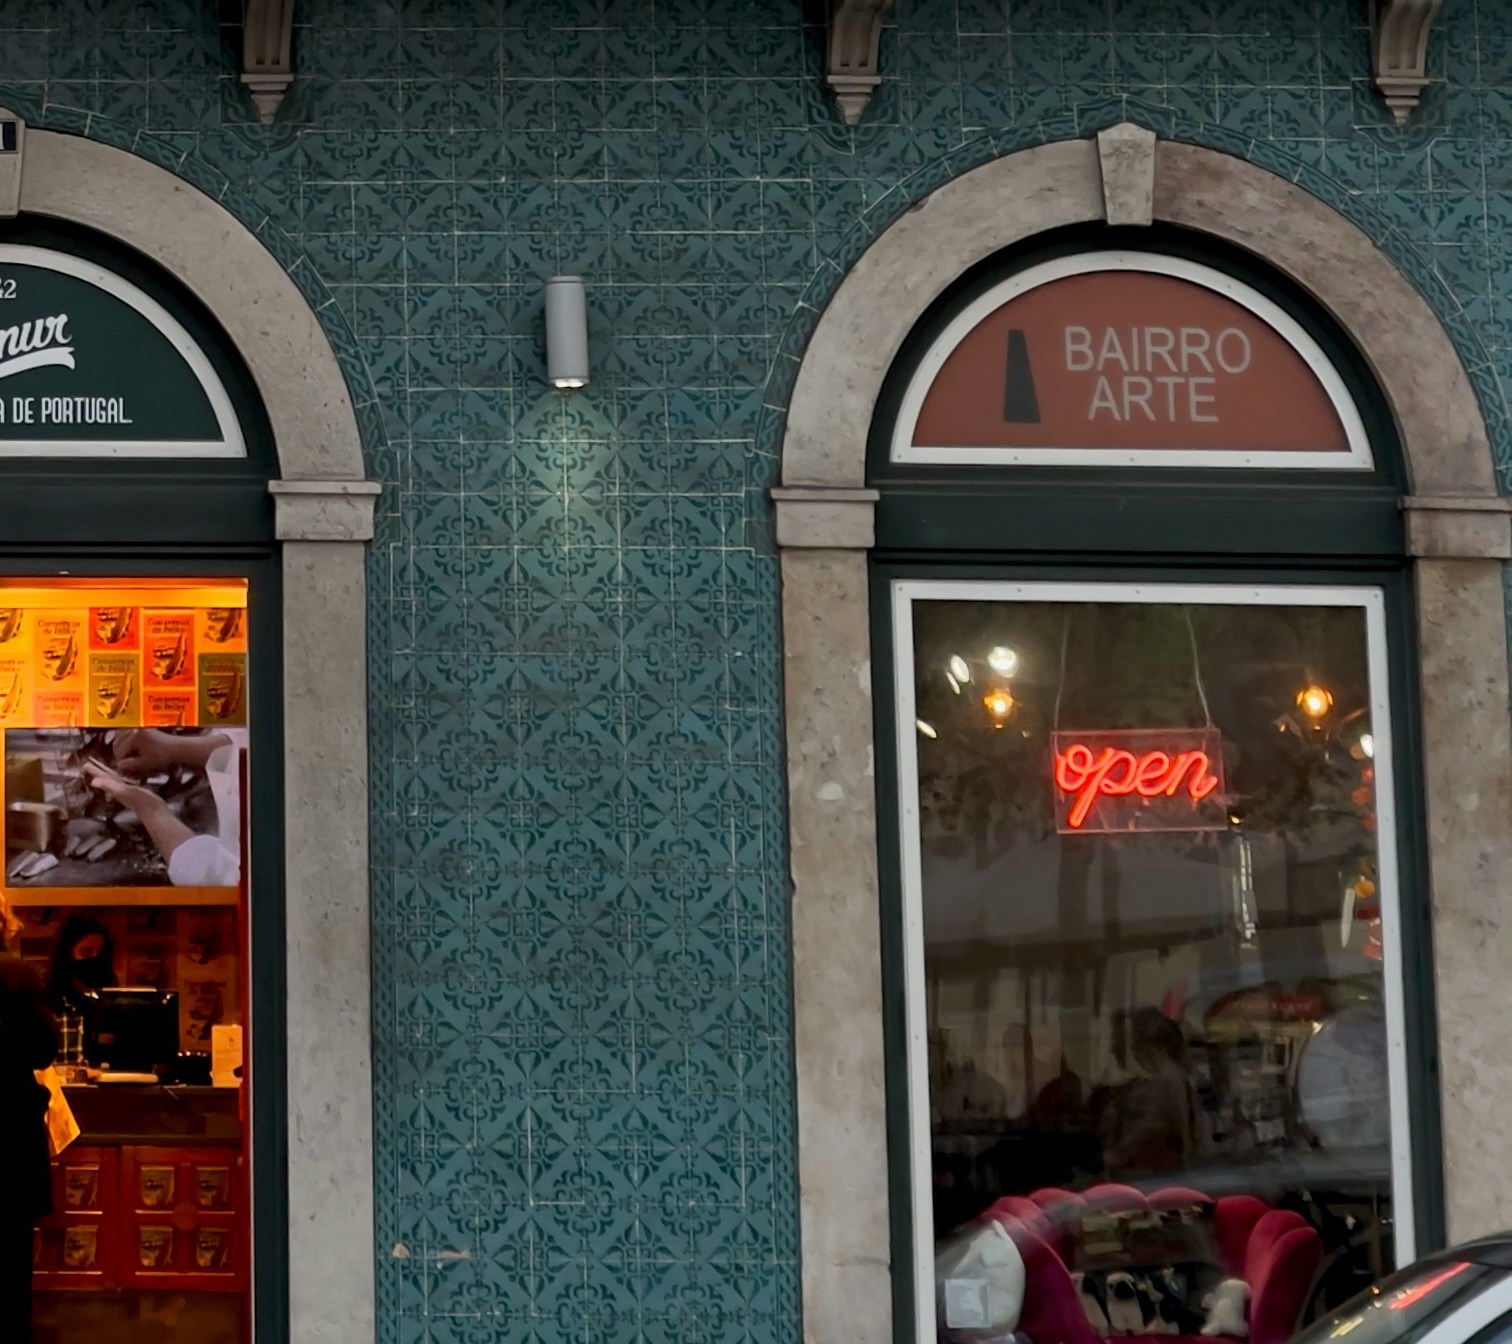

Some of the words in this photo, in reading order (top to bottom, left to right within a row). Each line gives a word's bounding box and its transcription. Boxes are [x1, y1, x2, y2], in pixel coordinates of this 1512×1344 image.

[1064, 326, 1252, 374] BAIRRO
[12, 397, 35, 424] DE
[1088, 375, 1219, 423] ARTE
[1056, 744, 1218, 828] open
